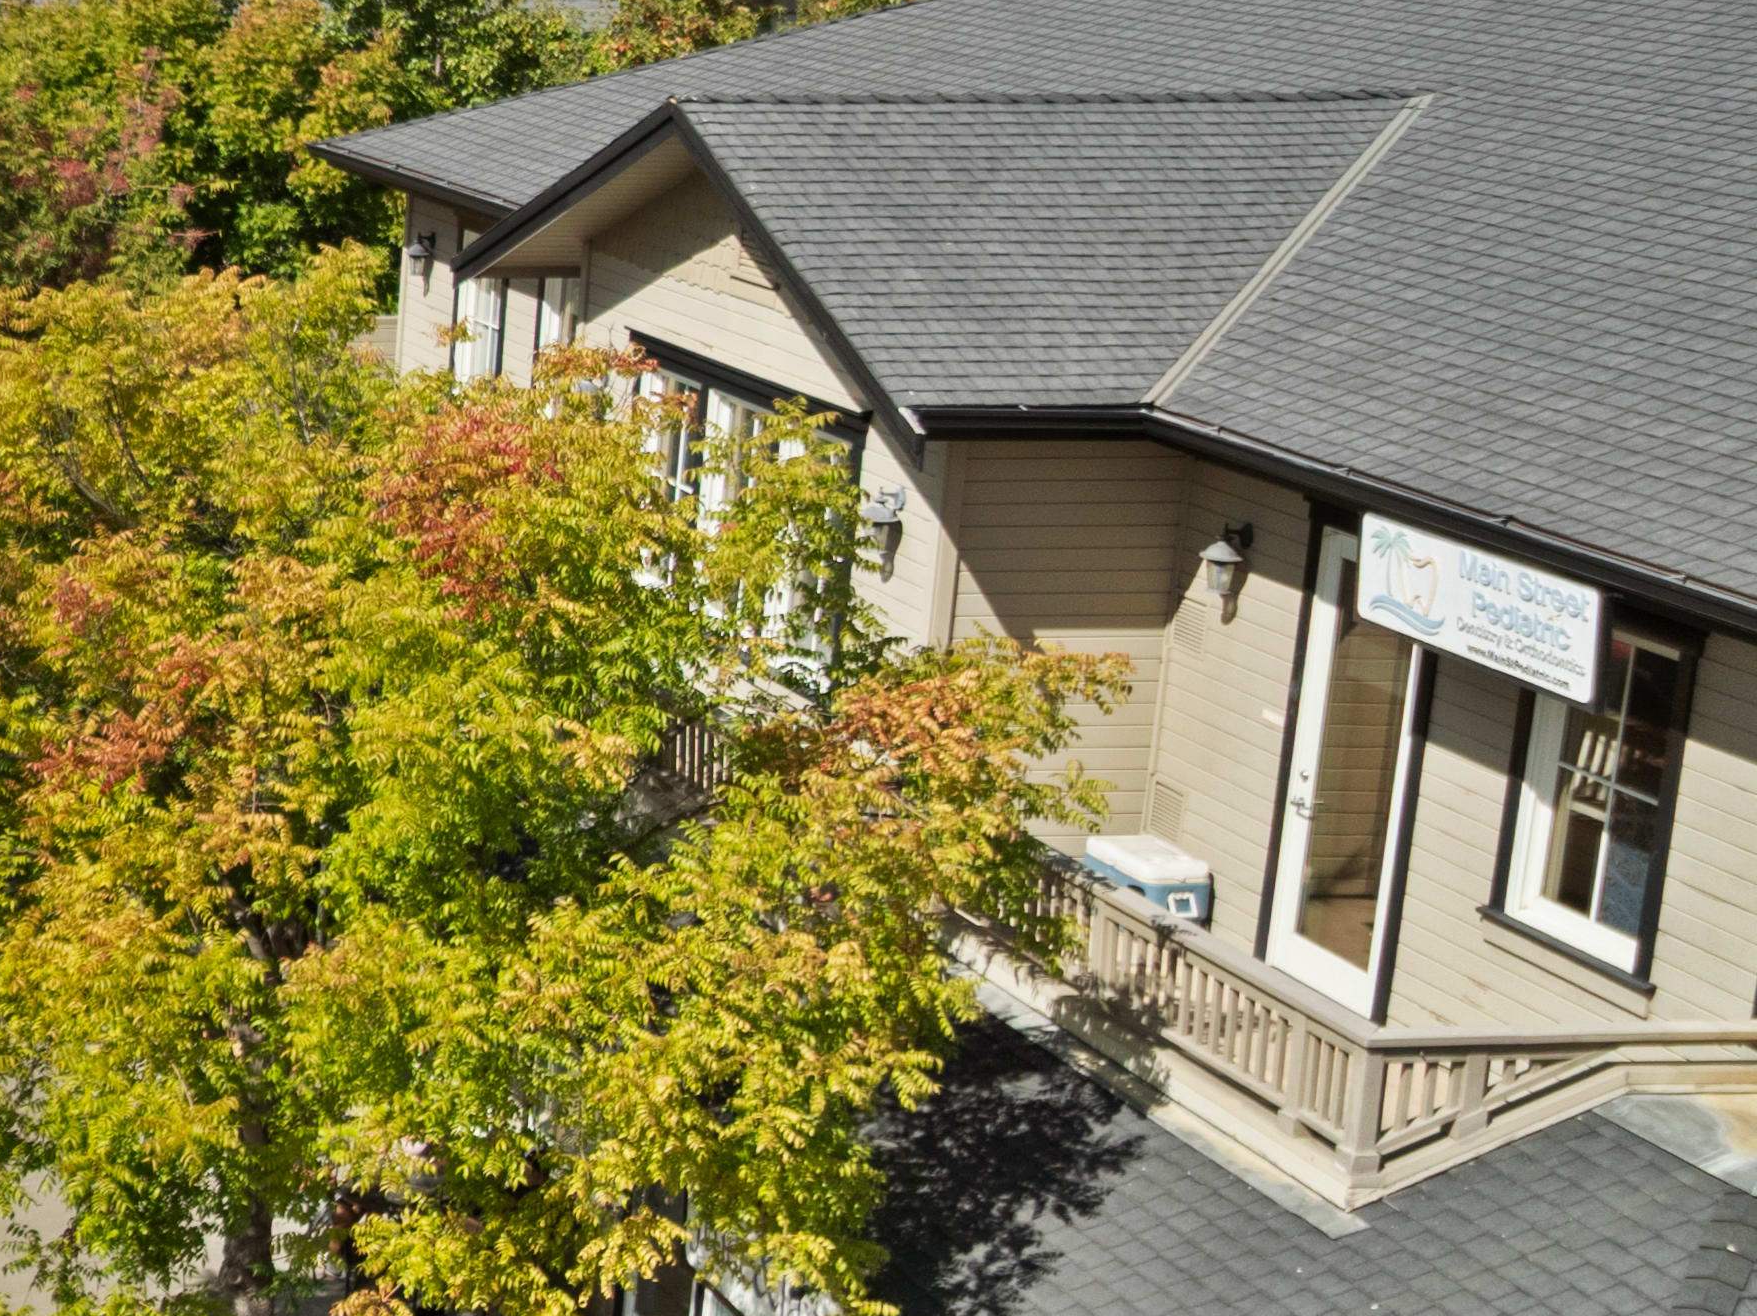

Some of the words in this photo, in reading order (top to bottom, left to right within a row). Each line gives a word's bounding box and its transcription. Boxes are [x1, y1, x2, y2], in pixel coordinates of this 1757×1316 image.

[1459, 551, 1511, 594] Main
[1518, 572, 1589, 623] Street
[1472, 591, 1572, 652] Pediatric
